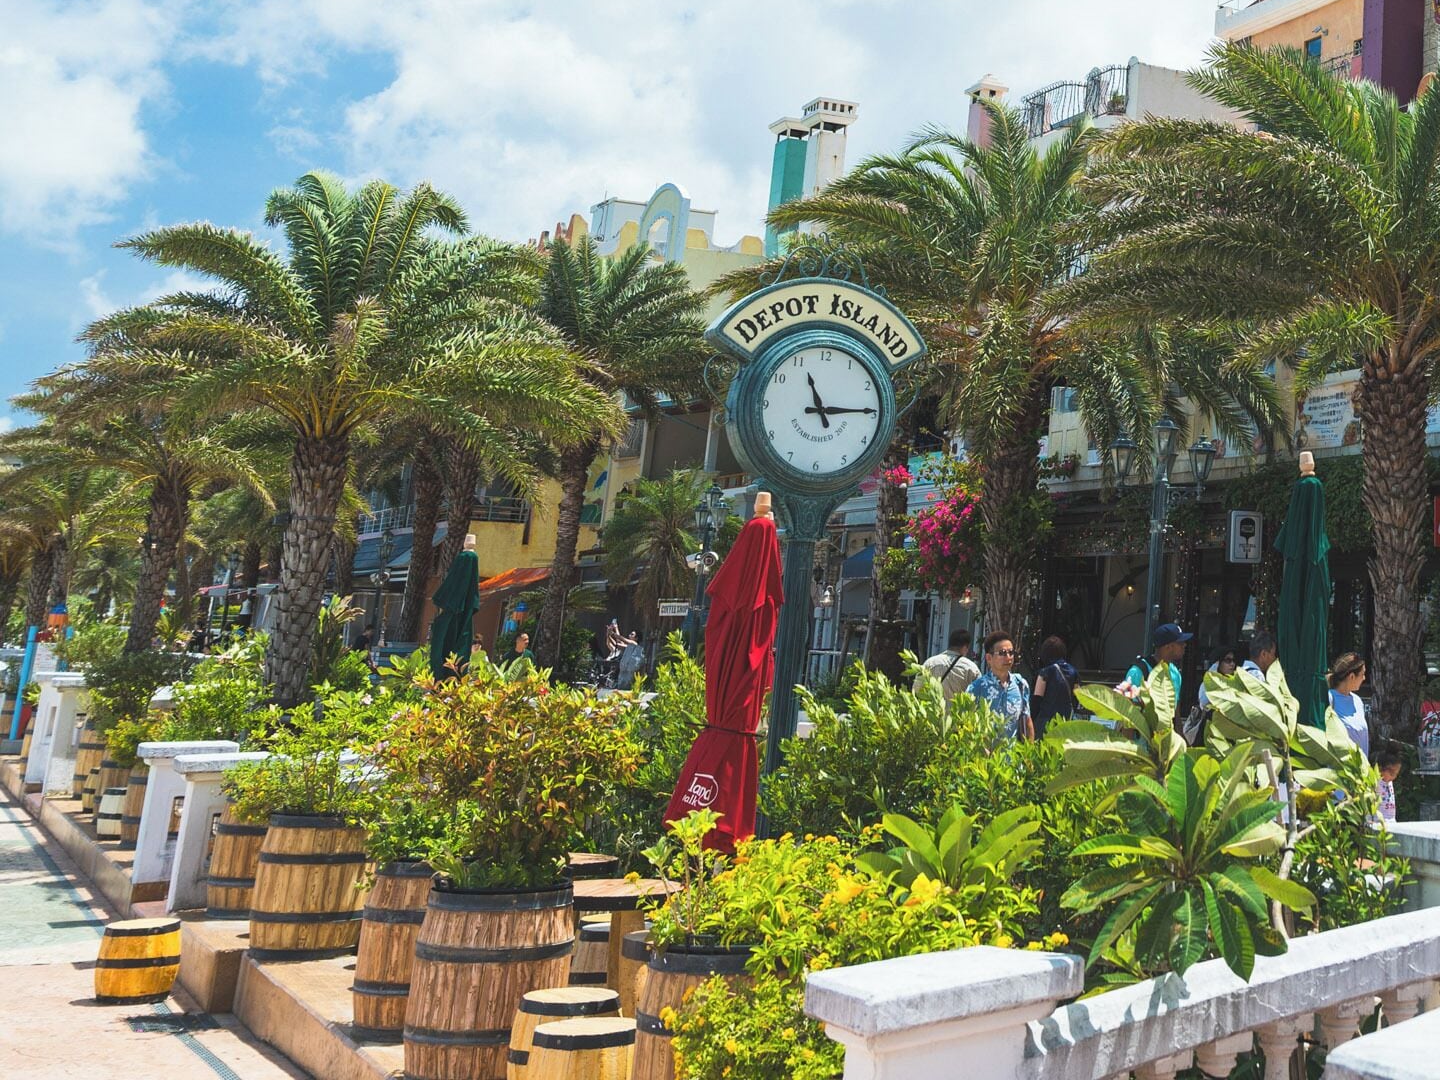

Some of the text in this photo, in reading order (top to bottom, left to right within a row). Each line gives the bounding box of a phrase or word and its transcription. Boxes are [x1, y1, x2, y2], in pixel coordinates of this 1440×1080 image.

[733, 293, 908, 359] DEPOT ISLAND
[820, 351, 832, 361] 12
[793, 356, 804, 367] 11
[847, 360, 852, 370] 1
[774, 373, 786, 384] 10
[864, 380, 871, 391] 2
[762, 400, 769, 410] 9
[768, 430, 775, 440] 8
[791, 418, 848, 443] ESTABLISHED 2010
[860, 435, 867, 445] 4
[787, 451, 794, 462] 7
[840, 455, 847, 465] 5
[812, 461, 819, 471] 6
